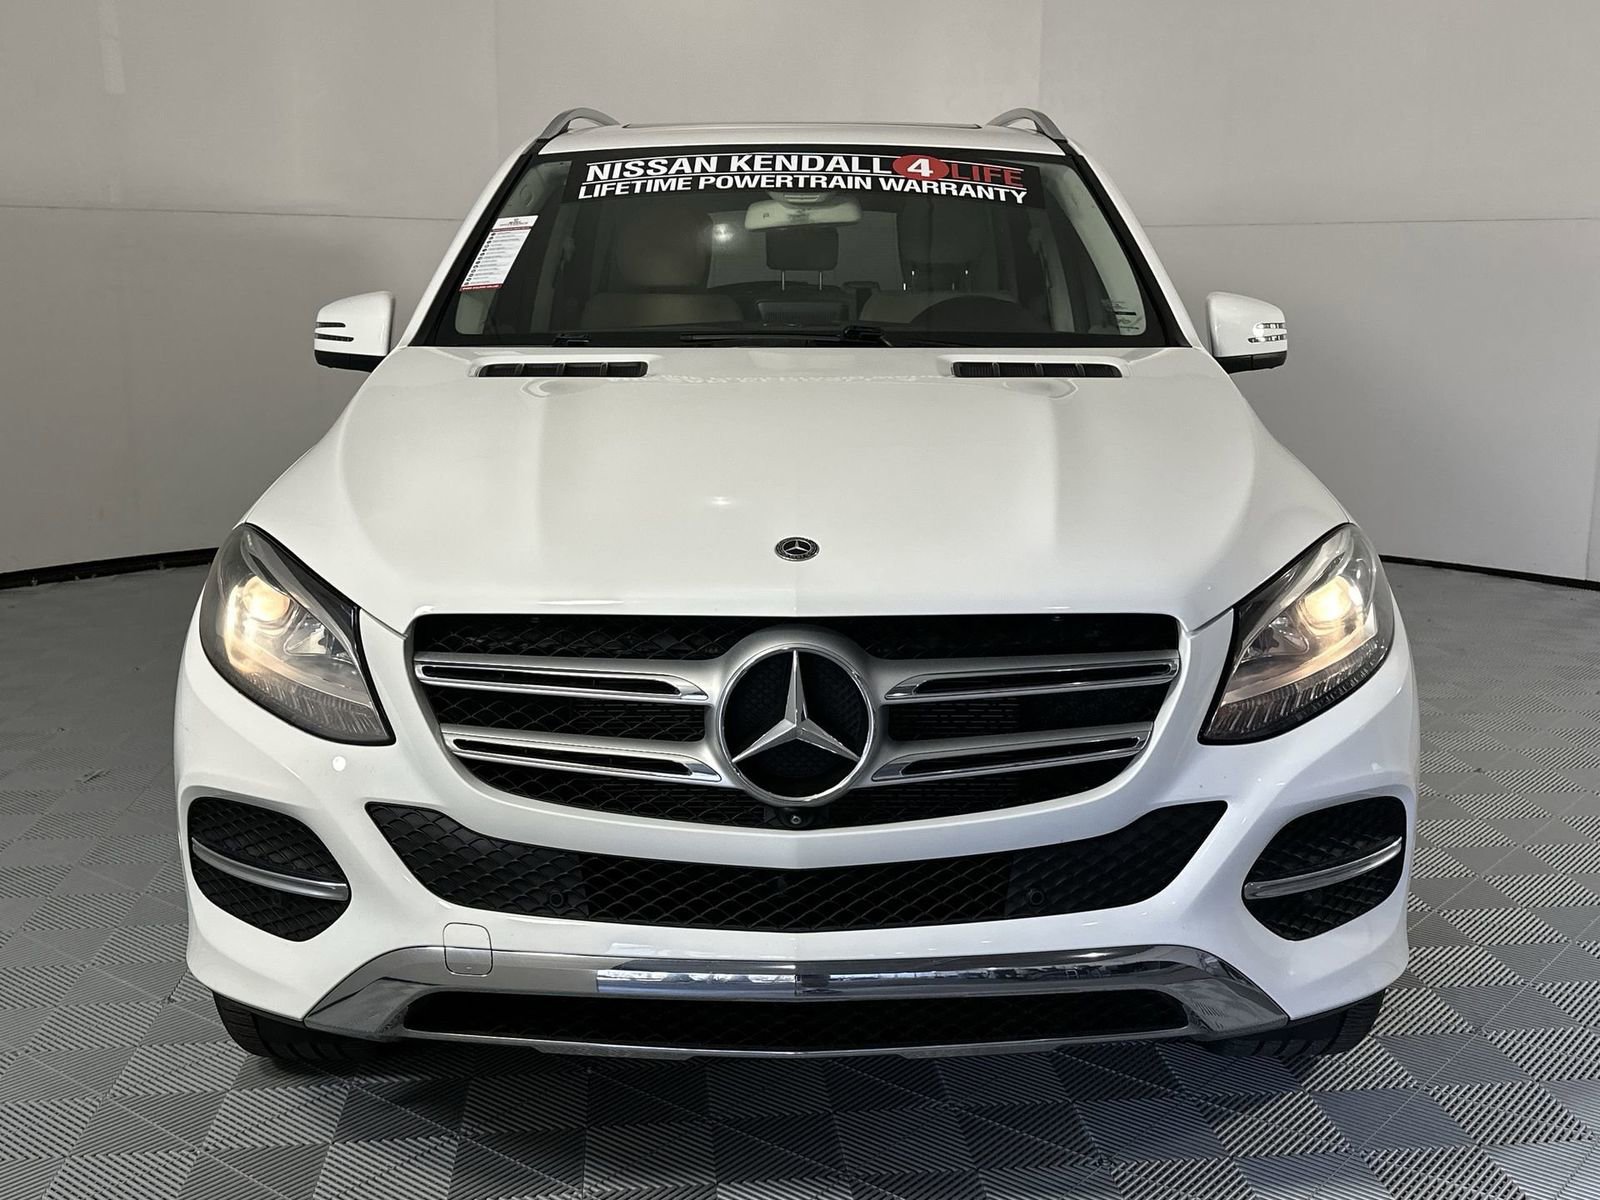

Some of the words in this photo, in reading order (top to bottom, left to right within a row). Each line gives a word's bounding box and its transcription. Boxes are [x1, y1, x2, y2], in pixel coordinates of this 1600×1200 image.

[586, 157, 717, 182] NISSAN
[729, 155, 892, 174] KENDALL
[907, 158, 934, 177] 4
[952, 164, 1024, 186] LIFE
[578, 178, 692, 200] LIFETIME
[698, 175, 872, 190] POWERTRAIN
[879, 178, 1027, 204] WARRANTY
